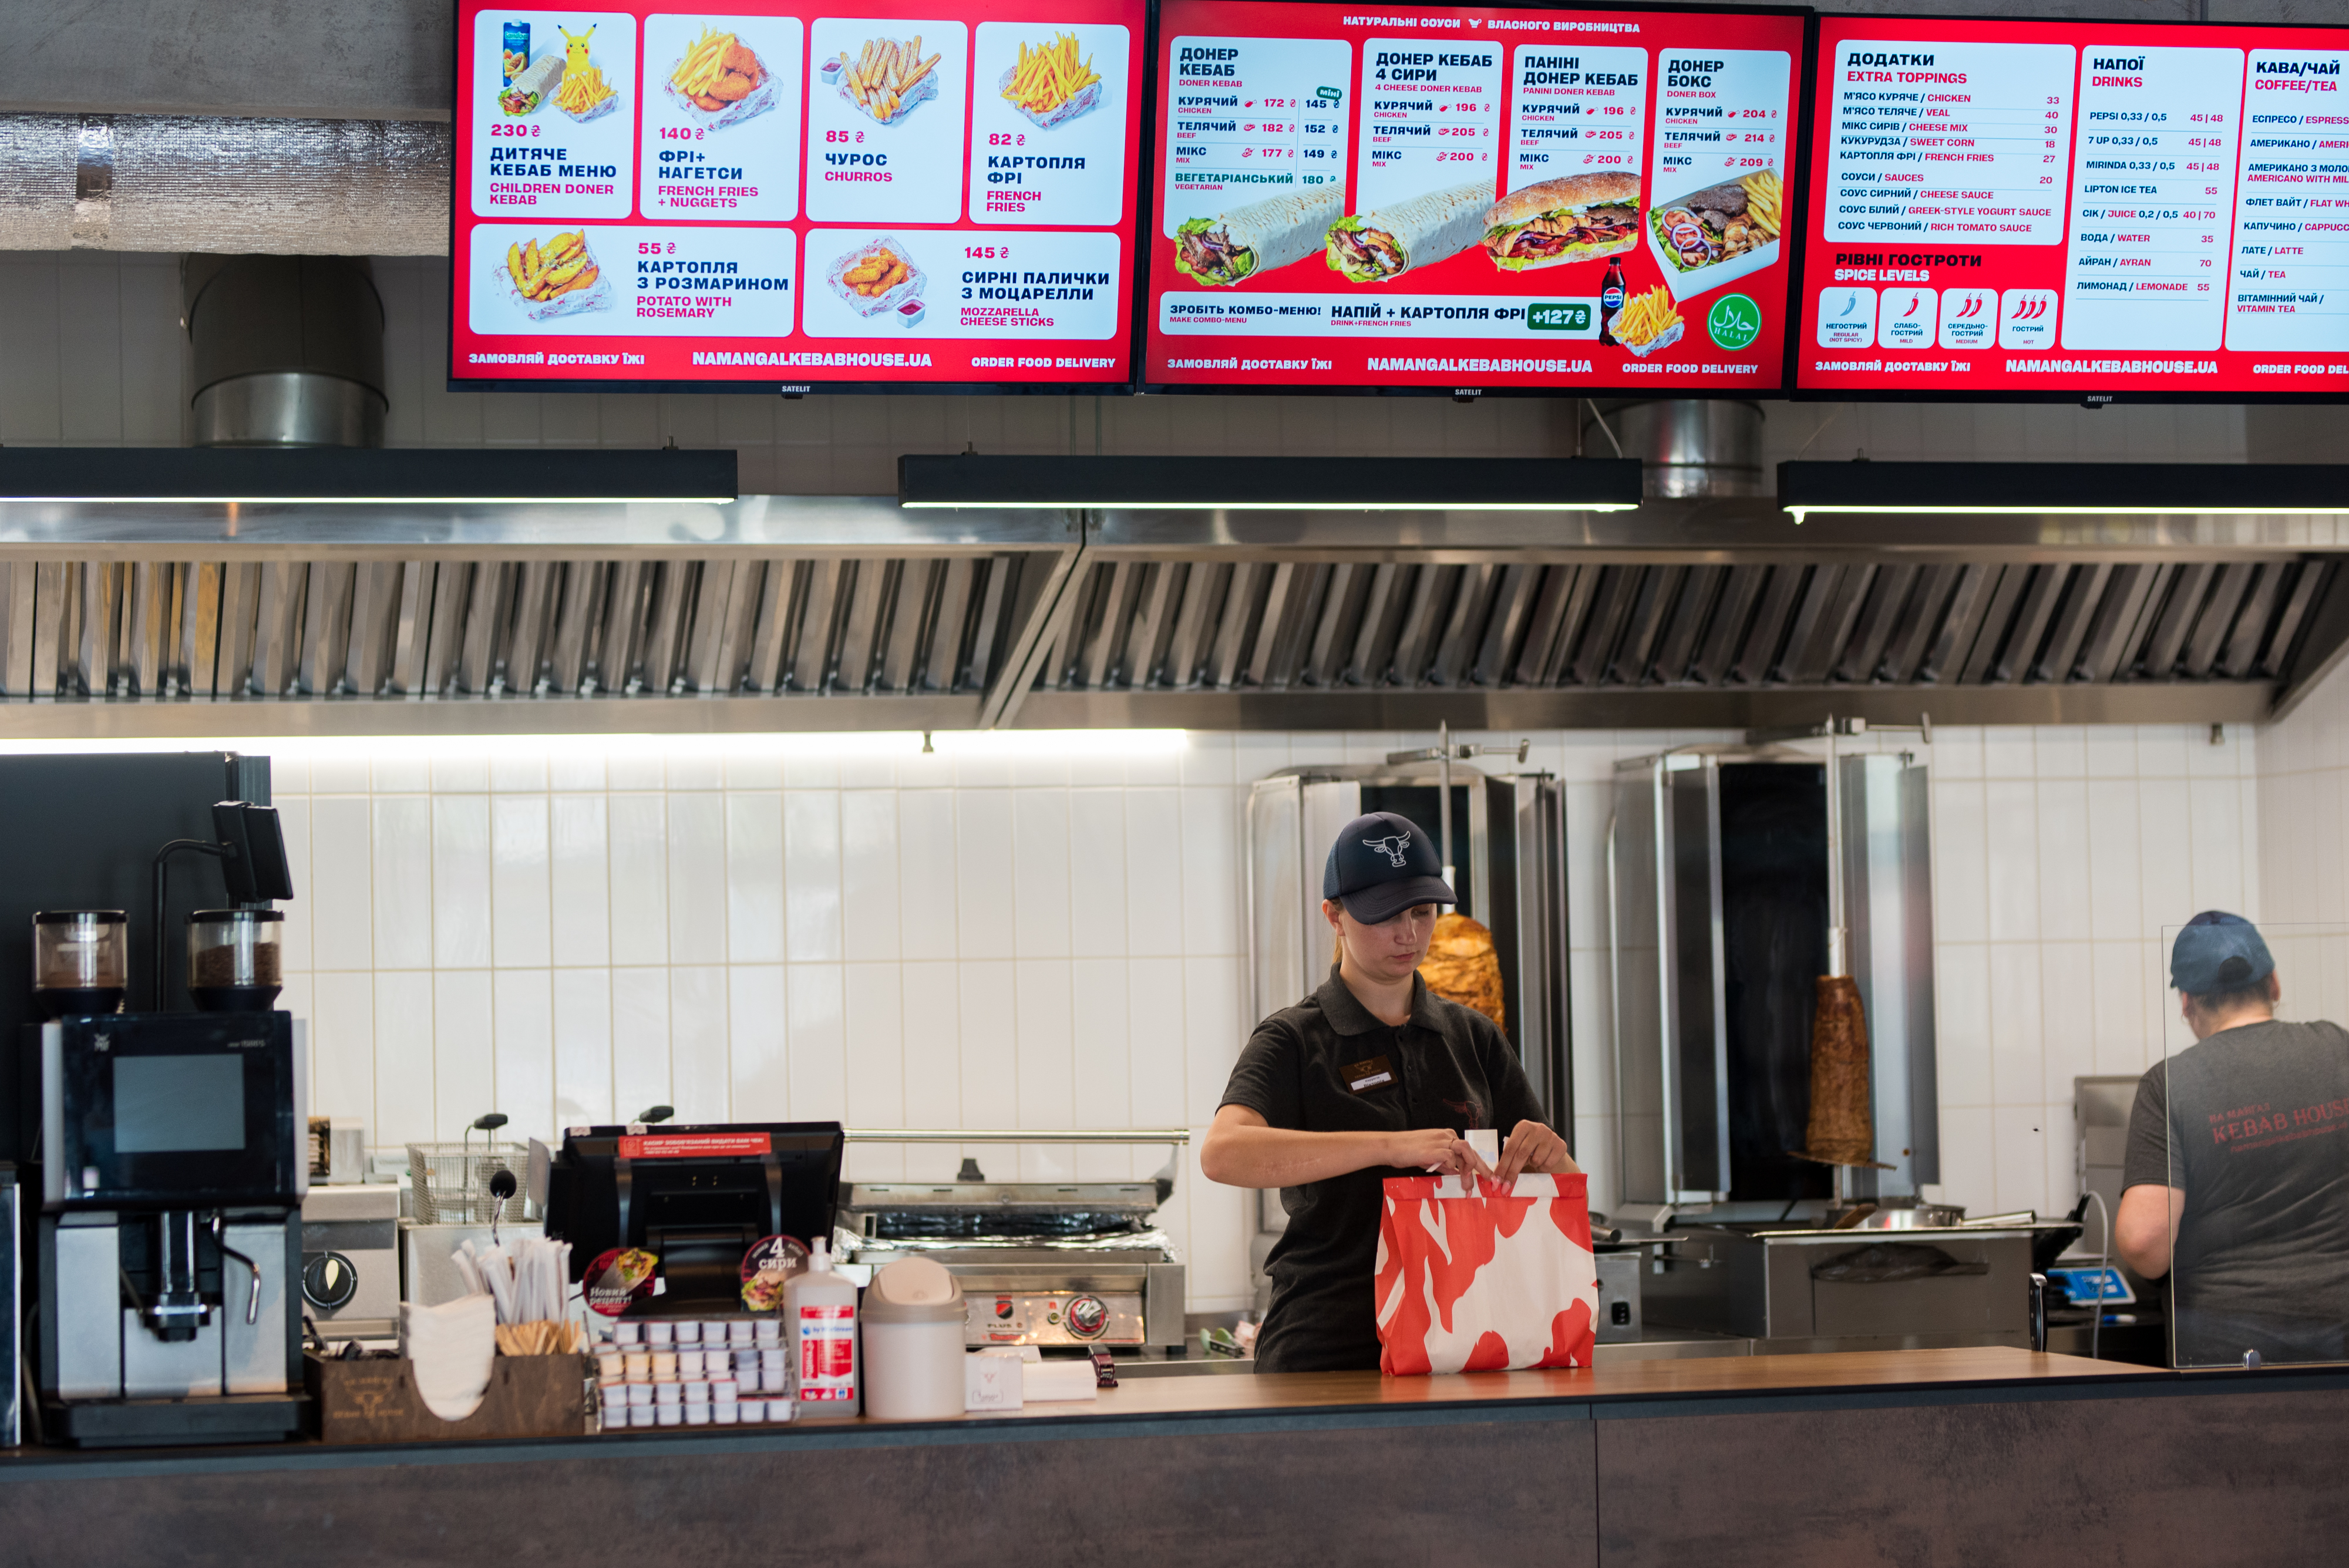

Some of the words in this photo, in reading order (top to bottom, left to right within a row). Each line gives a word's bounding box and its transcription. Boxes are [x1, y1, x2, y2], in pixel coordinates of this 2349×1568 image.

[1343, 16, 1417, 27] НАТУРАЛЬНІ
[1420, 18, 1460, 28] СОУСИ
[1488, 19, 1550, 31] ВЛАСНОГО
[1553, 21, 1640, 33] ВИРОБНИЦТВА
[1180, 48, 1239, 62] ДОНЕР
[1376, 52, 1434, 67] ДОНЕР
[1438, 54, 1492, 67] КЕБАБ
[1847, 53, 1934, 68] ДОДАТКИ
[1525, 56, 1579, 69] ПАНІНІ
[1668, 59, 1724, 73] ДОНЕР
[2093, 56, 2146, 70] НАПОЇ
[2256, 59, 2340, 77] КАВА/ЧАЙ
[1179, 63, 1235, 76] КЕБАБ
[1375, 68, 1386, 80] 4
[1391, 68, 1437, 81] СИРИ
[1179, 79, 1210, 87] DONER
[1523, 72, 1580, 86] ДОНЕР
[1585, 73, 1638, 86] КЕБАБ
[1668, 75, 1711, 88] БОКС
[1847, 70, 1893, 82] EXTRA
[1896, 72, 1967, 84] TOPPINGS
[2092, 76, 2143, 88] DRINKS
[1383, 83, 1418, 92] CHEESE
[2254, 79, 2337, 93] COFFEE/TEA
[1178, 95, 1238, 106] КУРЯЧИЙ
[1264, 98, 1284, 107] 172
[1305, 99, 1327, 109] 145
[1879, 93, 1919, 102] КУРЯЧЕ
[1927, 93, 1971, 103] CHICKEN
[2047, 96, 2059, 105] 33
[490, 123, 527, 137] 230
[1177, 120, 1236, 132] ТЕЛЯЧИЙ
[1262, 123, 1283, 132] 182
[1304, 124, 1325, 133] 152
[659, 127, 691, 140] 140
[826, 130, 849, 143] 85
[988, 133, 1012, 146] 82
[490, 147, 567, 161] ДИТЯЧЕ
[659, 150, 705, 163] ФРІ+
[1176, 146, 1207, 156] МІКС
[1262, 149, 1283, 157] 177
[1303, 149, 1325, 159] 149
[825, 153, 887, 166] ЧУРОС
[988, 156, 1085, 170] КАРТОПЛЯ
[490, 163, 551, 177] КЕБАБ
[558, 164, 617, 178] МЕНЮ
[659, 166, 742, 180] НАГЕТСИ
[824, 171, 893, 182] CHURROS
[987, 171, 1022, 184] ФРІ
[1175, 173, 1293, 184] ВЕГЕТАРІАНСЬКИЙ
[1302, 176, 1324, 184] 180
[490, 182, 561, 194] CHILDREN
[565, 184, 614, 194] DONER
[658, 185, 715, 196] FRENCH
[718, 186, 759, 197] FRIES
[2084, 185, 2119, 193] LIPTON
[2121, 186, 2137, 194] ICE
[2139, 186, 2157, 194] TEA
[2205, 187, 2217, 195] 55
[490, 194, 537, 205] KEBAB
[987, 190, 1042, 201] FRENCH
[670, 197, 738, 208] NUGGETS
[986, 202, 1025, 213] FRIES
[1839, 205, 1866, 214] СОУС
[1869, 204, 1899, 214] БІЛИЙ
[1908, 206, 1975, 215] GREEK-STYLE
[1977, 207, 2017, 216] YOGURT
[2019, 208, 2051, 216] SAUCE
[638, 242, 661, 255] 55
[964, 247, 995, 259] 145
[1836, 253, 1883, 265] РІВНІ
[1888, 254, 1982, 267] ГОСТРОТИ
[638, 261, 738, 274] КАРТОПЛЯ
[962, 271, 1017, 284] СИРНІ
[1024, 272, 1109, 285] ПАЛИЧКИ
[1835, 268, 1877, 281] SPICE
[1879, 269, 1930, 282] LEVELS
[637, 277, 648, 289] З
[655, 277, 789, 291] РОЗМАРИНОМ
[2077, 282, 2127, 291] ЛИМОНАД
[2136, 282, 2188, 291] LEMONADE
[2197, 283, 2210, 291] 55
[637, 295, 692, 307] POTATO
[695, 296, 732, 307] WITH
[961, 287, 972, 300] З
[979, 287, 1093, 302] МОЦАРЕЛЛИ
[637, 307, 715, 318] ROSEMARY
[961, 307, 1039, 317] MOZZARELLA
[1170, 305, 1224, 314] ЗРОБІТЬ
[1229, 305, 1321, 315] КОМБО-МЕНЮ!
[1331, 303, 1381, 318] НАПІЙ
[1386, 308, 1395, 318] +
[1401, 307, 1489, 319] КАРТОПЛЯ
[1494, 308, 1526, 320] ФРІ
[960, 317, 1007, 326] CHEESE
[1010, 317, 1054, 327] STICKS
[1714, 327, 1748, 341] HALAL
[469, 351, 544, 364] ЗАМОВЛЯЙ
[547, 354, 620, 365] ДОСТАВКУ
[622, 352, 645, 365] ЇЖІ
[692, 352, 933, 367] NAMANGALKEBABHOUSE.UA
[971, 357, 1014, 367] ORDER
[1018, 357, 1052, 368] FOOD
[1056, 358, 1116, 368] DELIVERY
[2212, 1113, 2289, 1145] KEBAB
[769, 1236, 785, 1258] 4
[758, 1257, 797, 1271] сири
